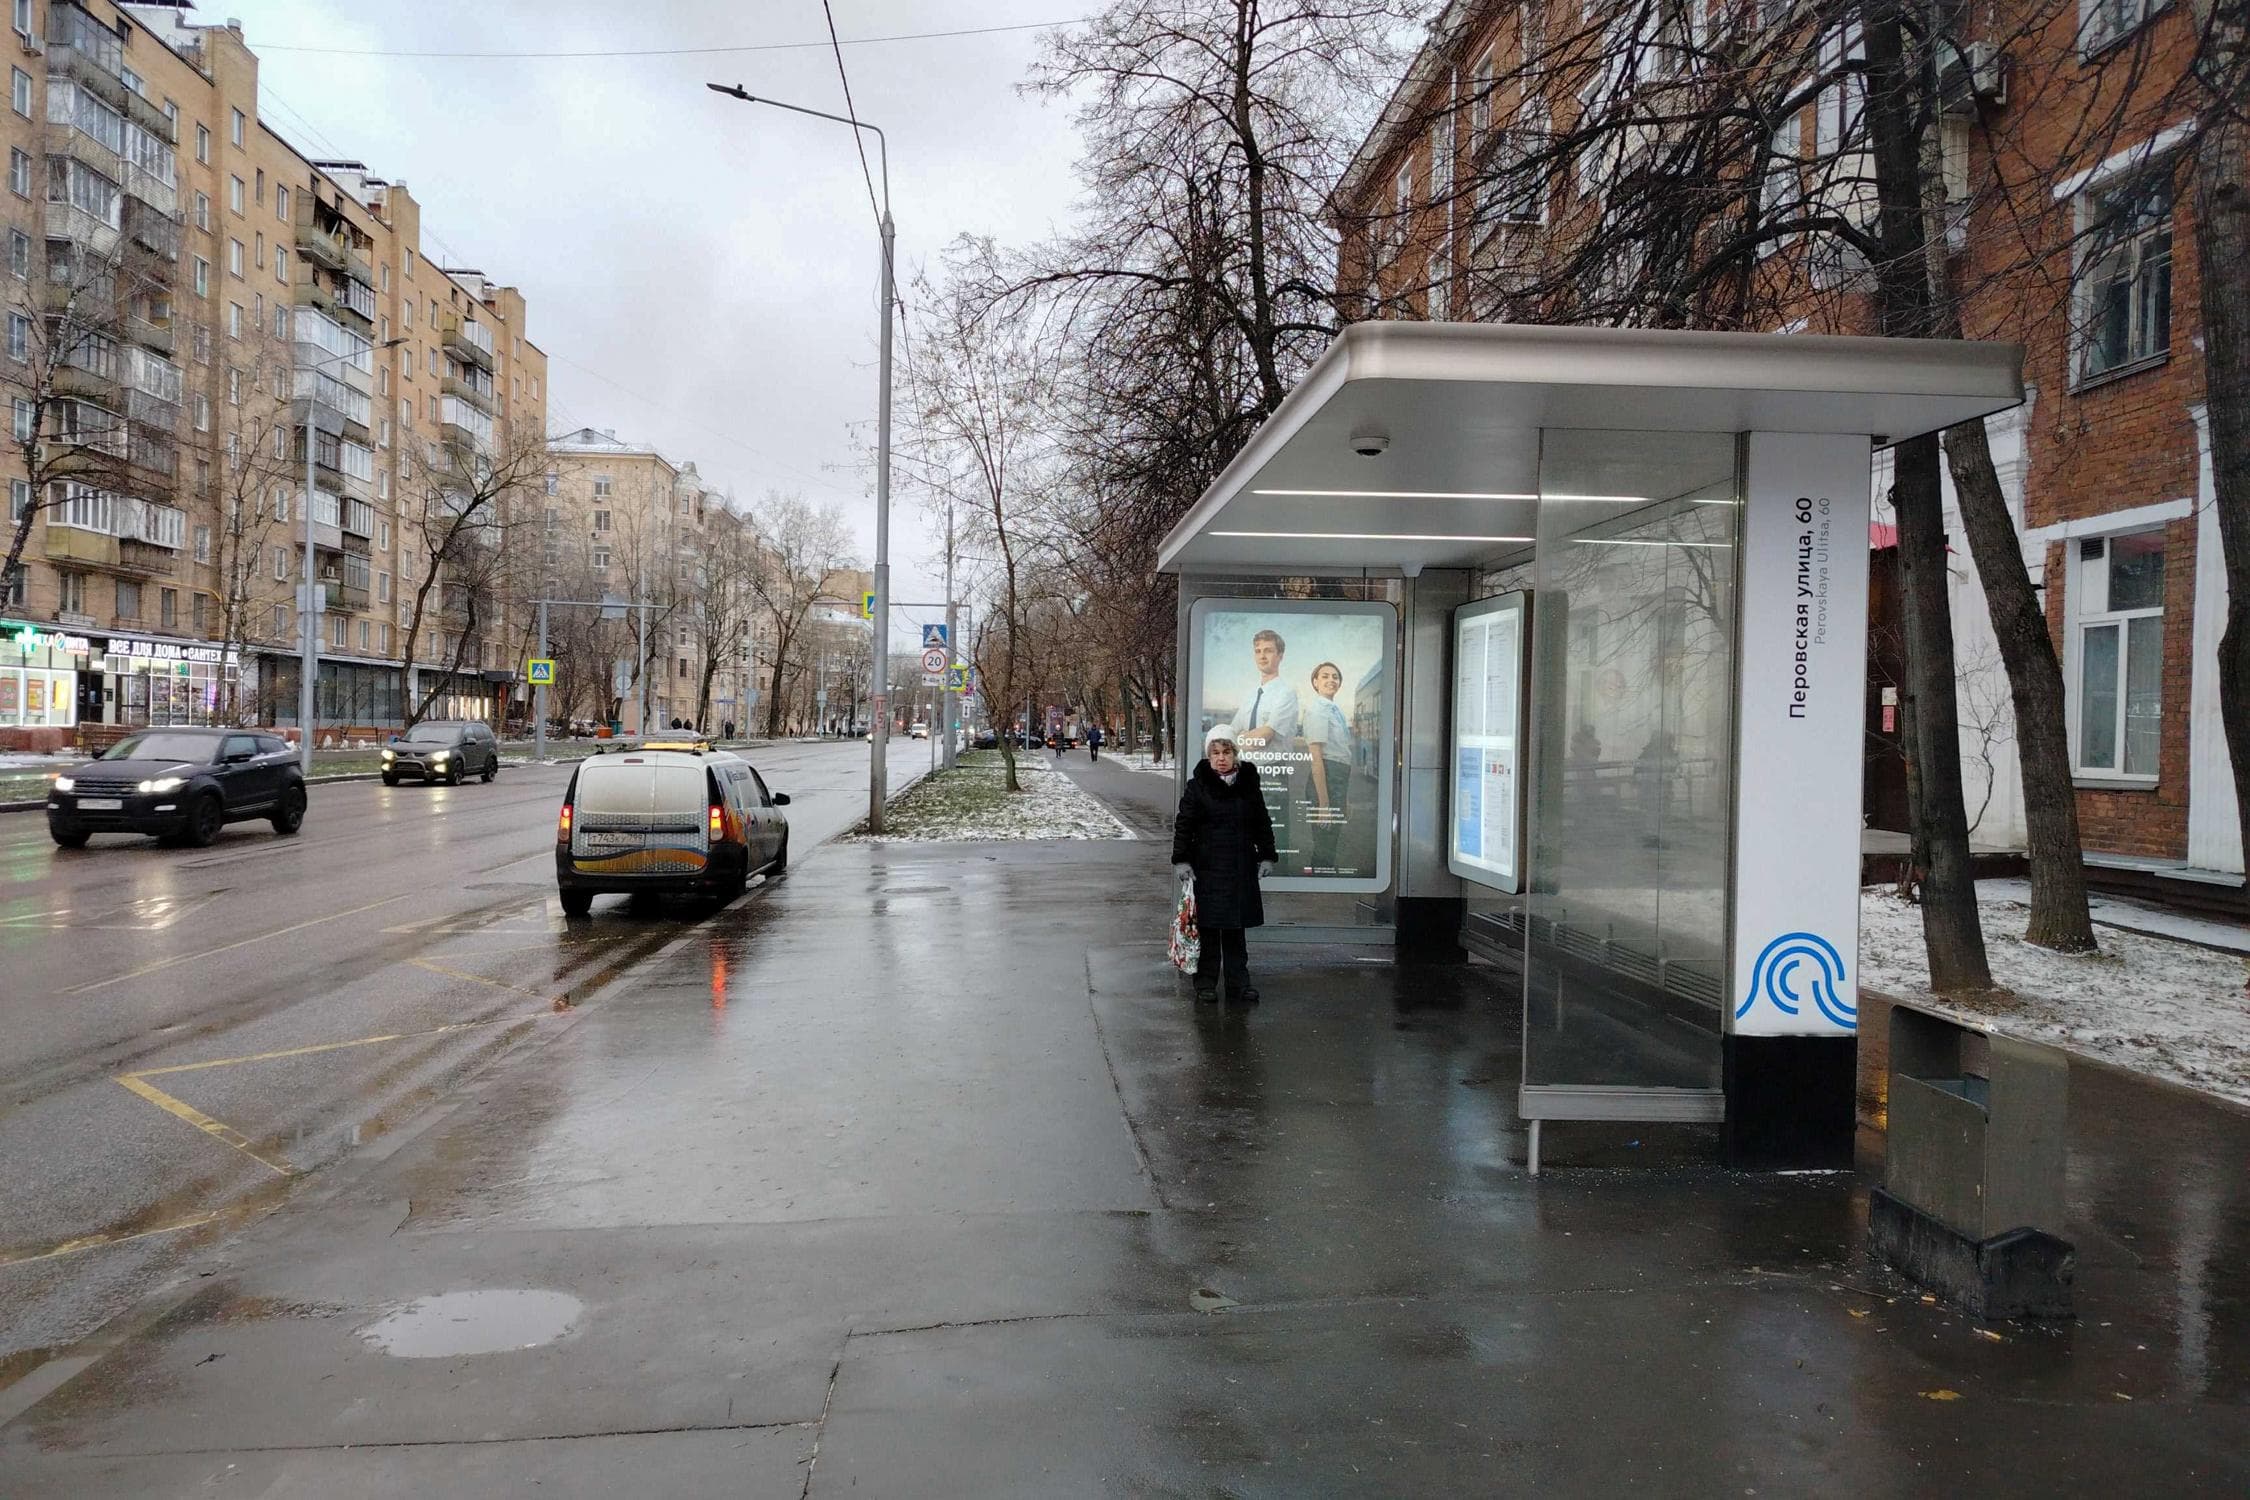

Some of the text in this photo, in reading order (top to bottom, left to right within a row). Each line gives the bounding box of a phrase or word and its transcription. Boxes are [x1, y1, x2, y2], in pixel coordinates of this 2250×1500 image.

[1814, 497, 1832, 644] Perovskaya Ulitsa, 60
[1789, 497, 1816, 718] Перовская улица, 60
[108, 639, 130, 655] ВСЕ
[132, 641, 153, 658] ДЛЯ
[154, 643, 181, 660] ДОМА
[187, 647, 239, 665] САНТЕХИК
[927, 656, 942, 667] 20
[1236, 734, 1266, 747] бота
[1256, 765, 1295, 777] порте
